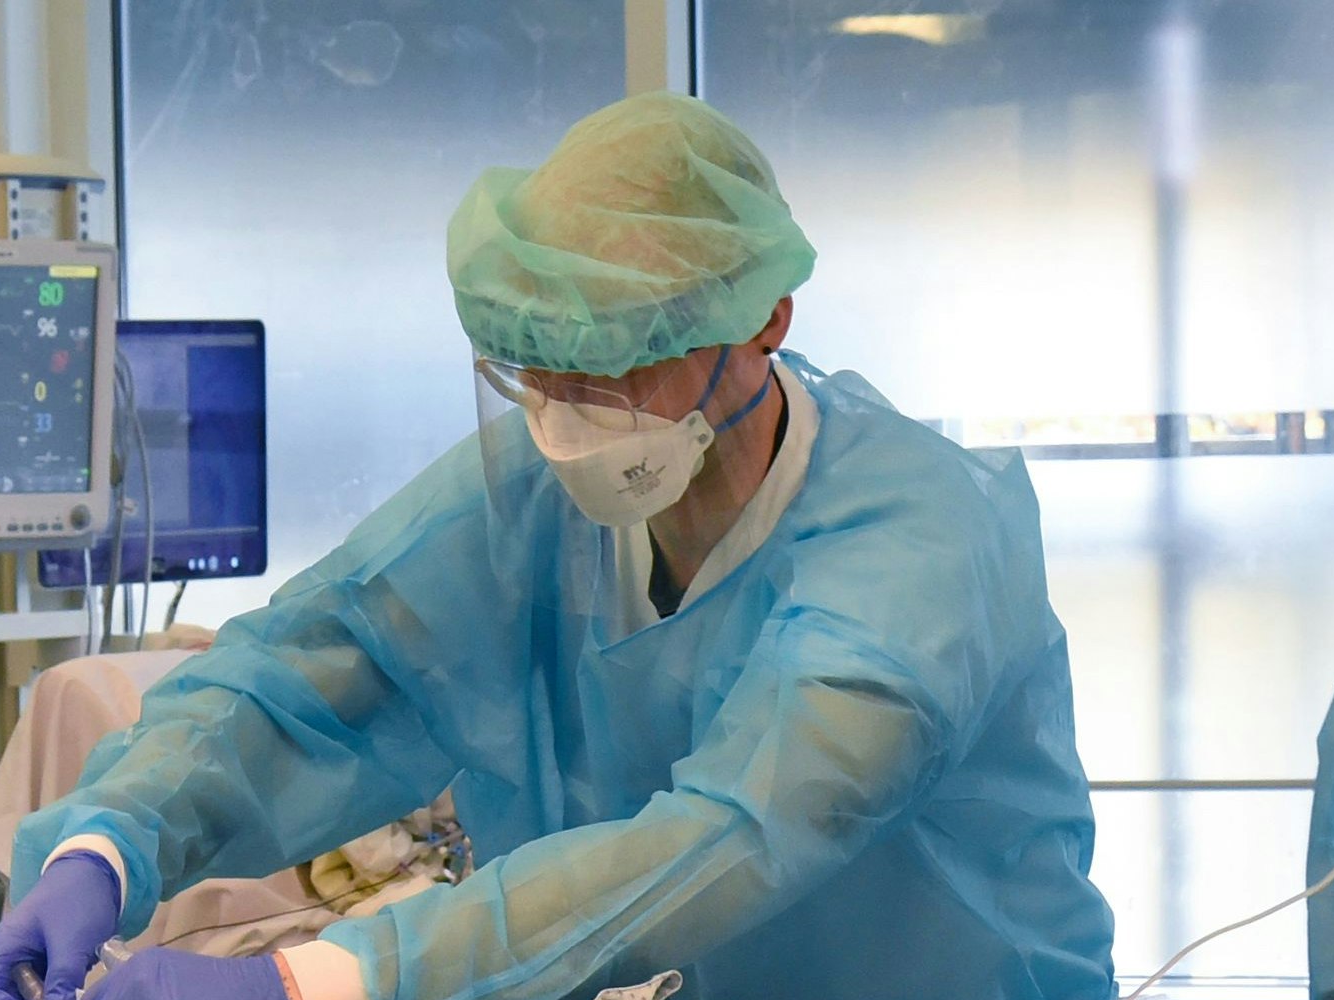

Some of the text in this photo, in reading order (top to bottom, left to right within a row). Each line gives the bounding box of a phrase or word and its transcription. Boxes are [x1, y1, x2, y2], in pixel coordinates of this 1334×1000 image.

[38, 281, 64, 307] 80
[37, 317, 58, 338] 96
[34, 381, 47, 402] 0
